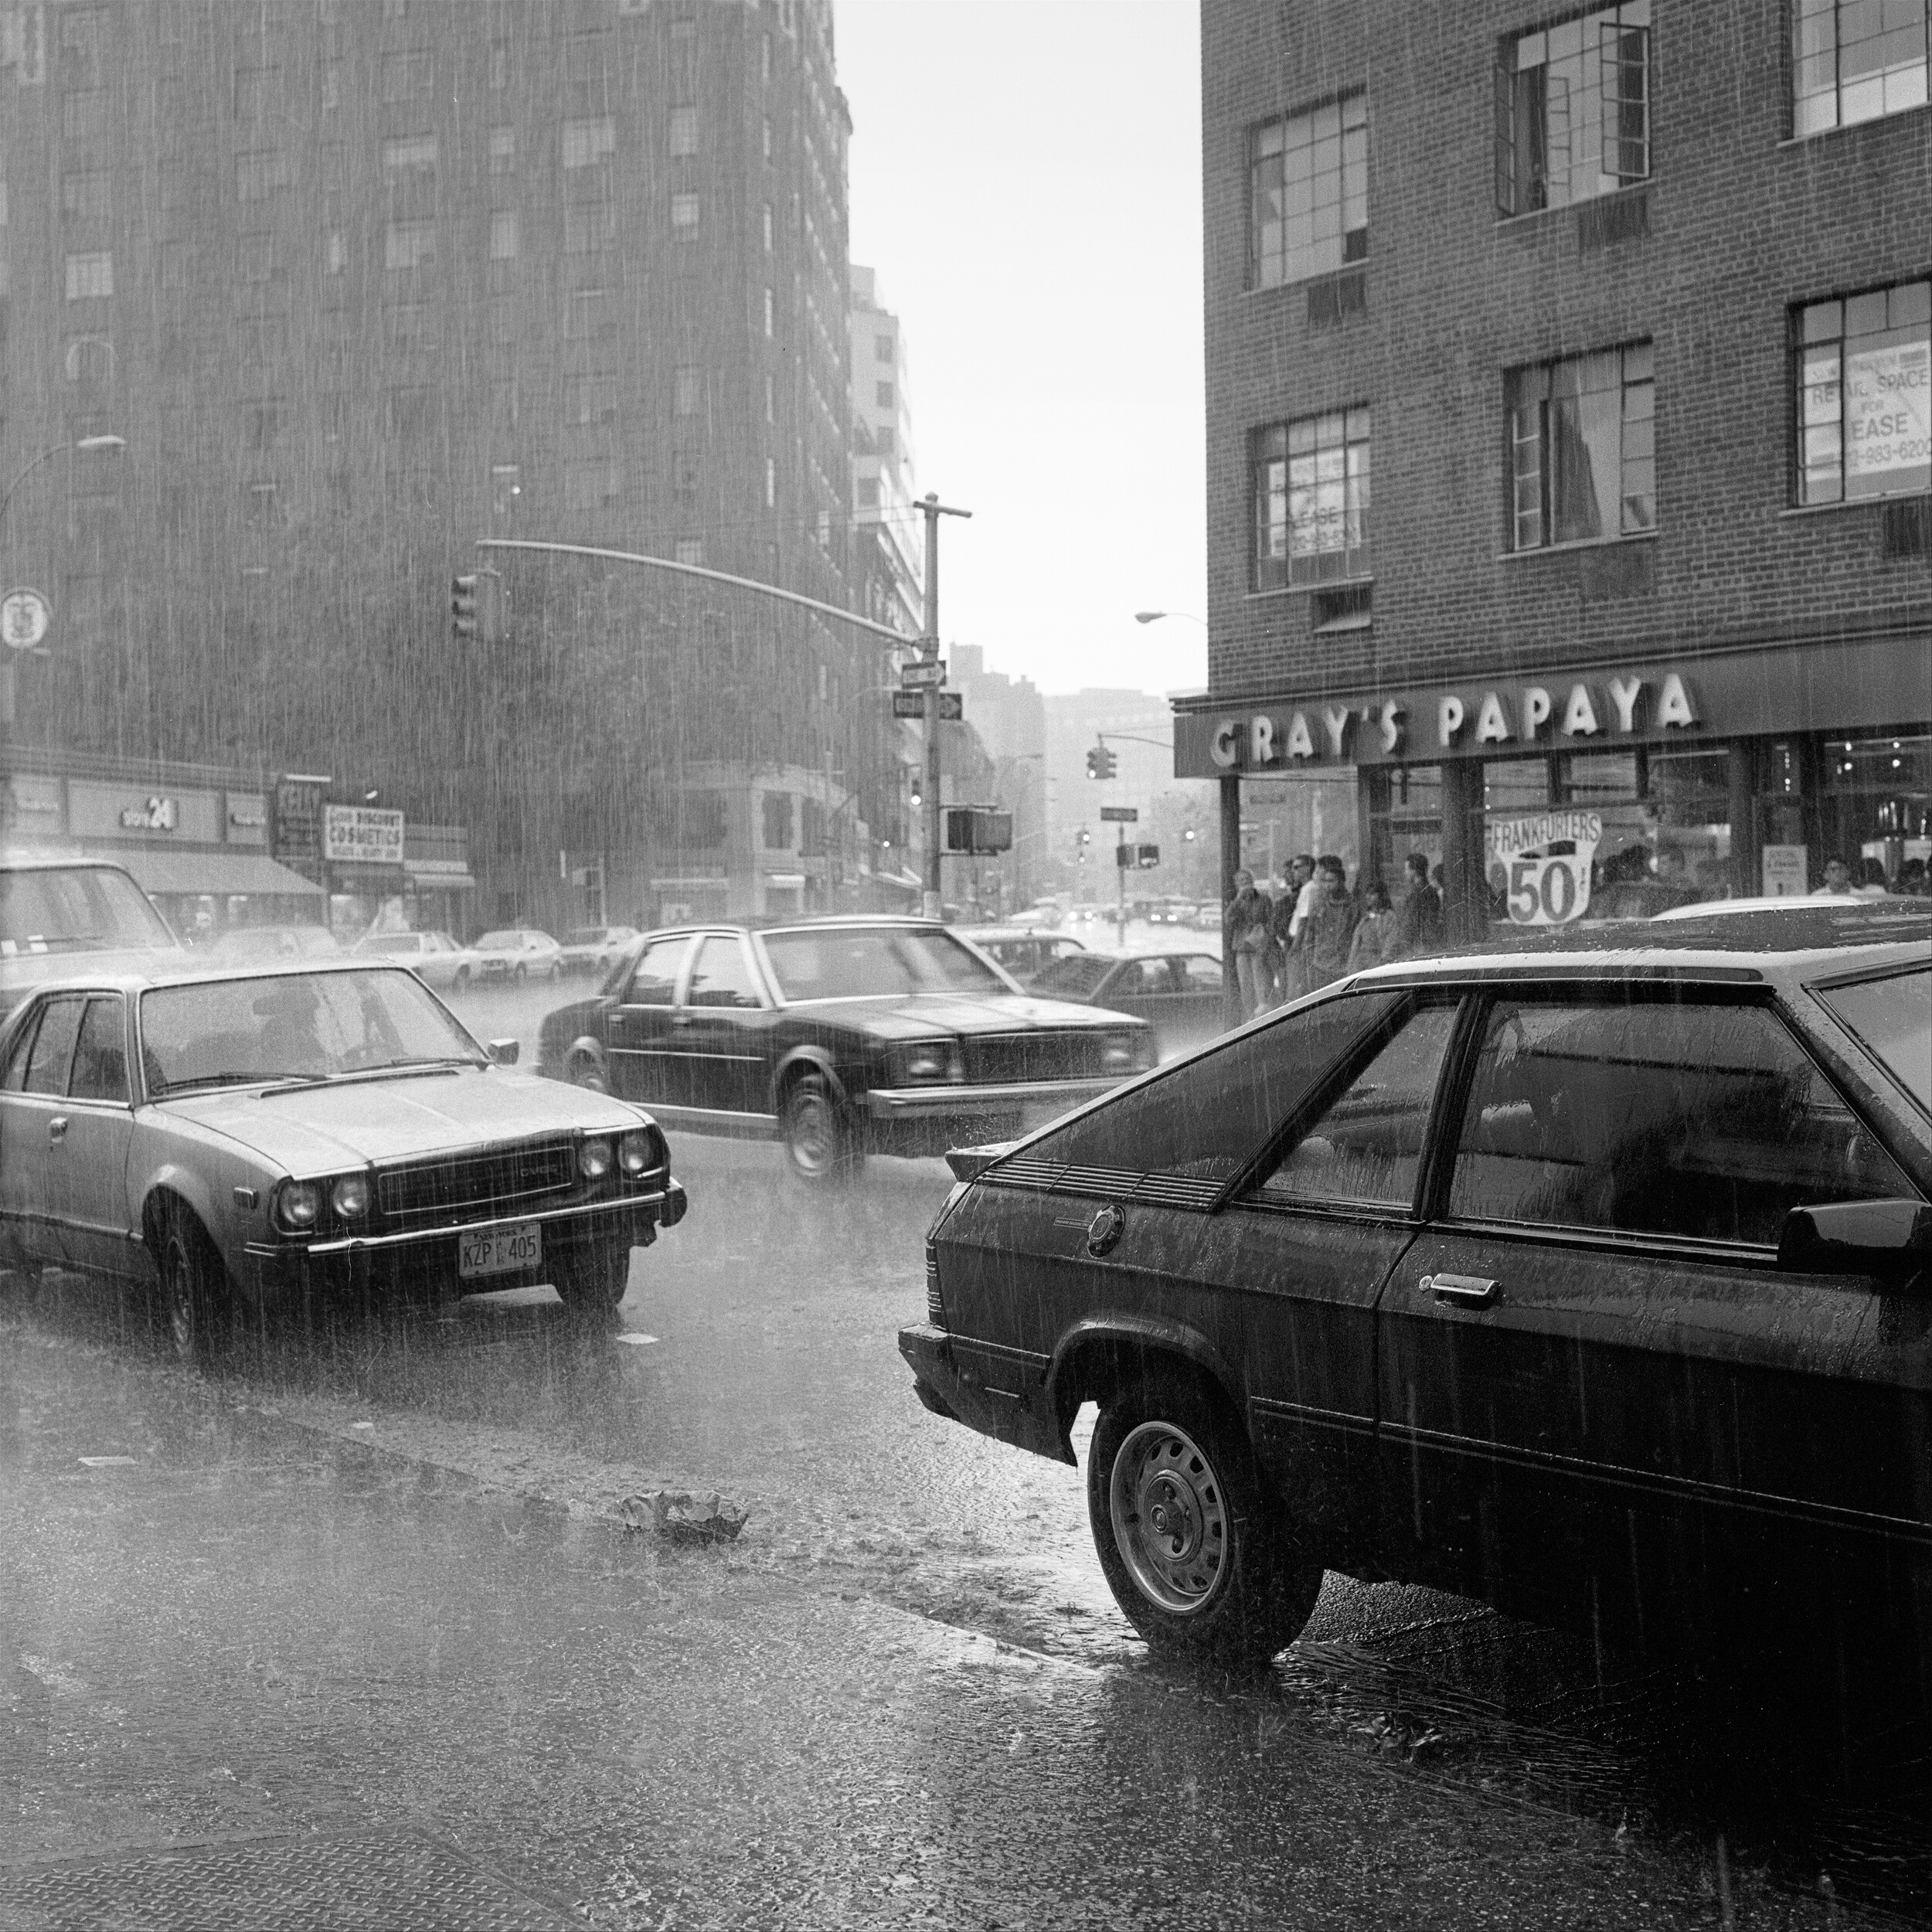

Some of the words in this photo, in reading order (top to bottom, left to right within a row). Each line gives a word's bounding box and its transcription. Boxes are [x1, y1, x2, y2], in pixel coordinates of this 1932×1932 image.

[1876, 369, 1930, 393] SPACE
[1852, 412, 1909, 440] EASE
[1210, 699, 1398, 767] GRAY'S
[1437, 674, 1693, 747] PAPAYA
[329, 826, 400, 846] COSMETICS
[1492, 814, 1599, 852] FRANKFURTERS
[1510, 861, 1577, 922] 50
[464, 1241, 492, 1267] KZP
[509, 1234, 536, 1260] 405
